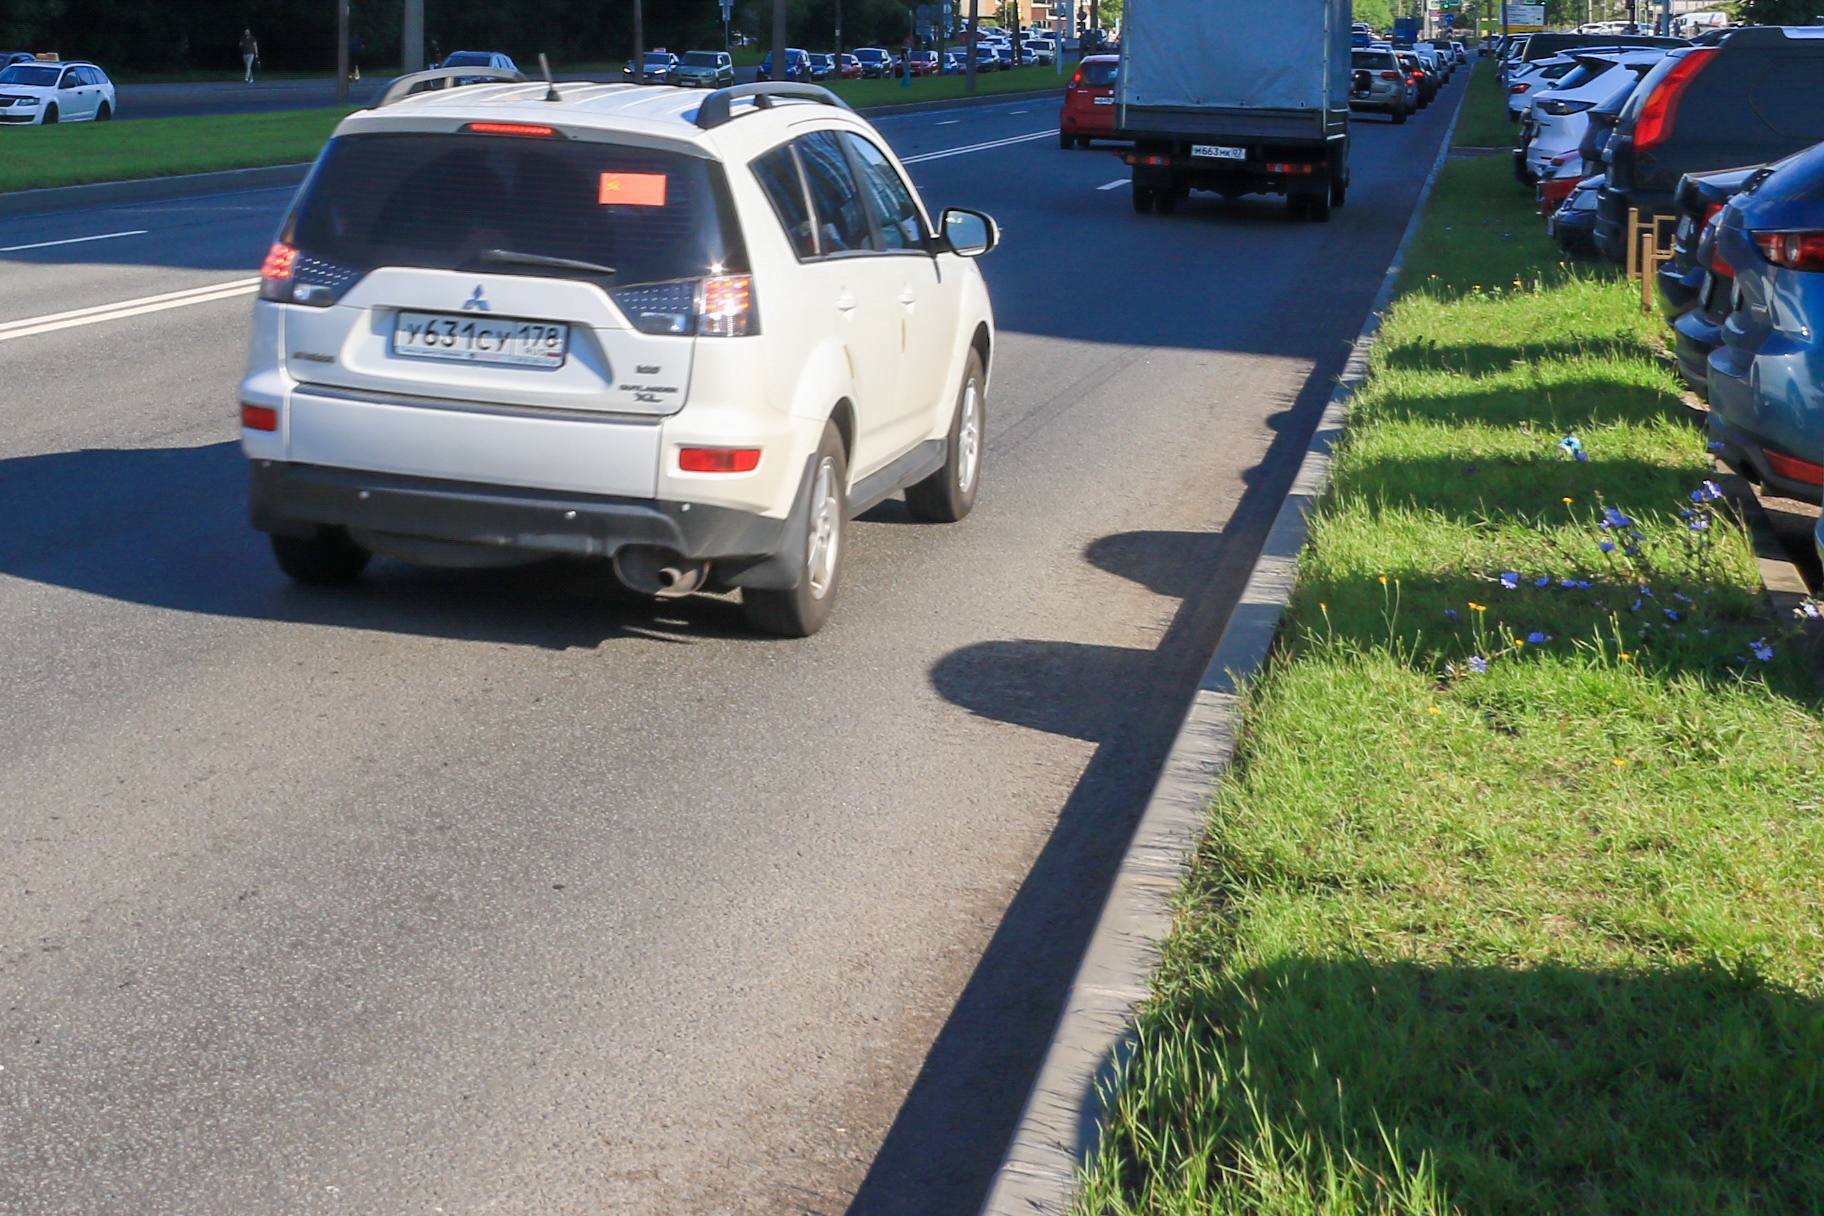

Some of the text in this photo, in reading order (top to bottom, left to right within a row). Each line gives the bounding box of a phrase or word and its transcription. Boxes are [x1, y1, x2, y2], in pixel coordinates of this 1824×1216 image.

[405, 319, 561, 351] У631СУ 178
[634, 392, 663, 403] XL
